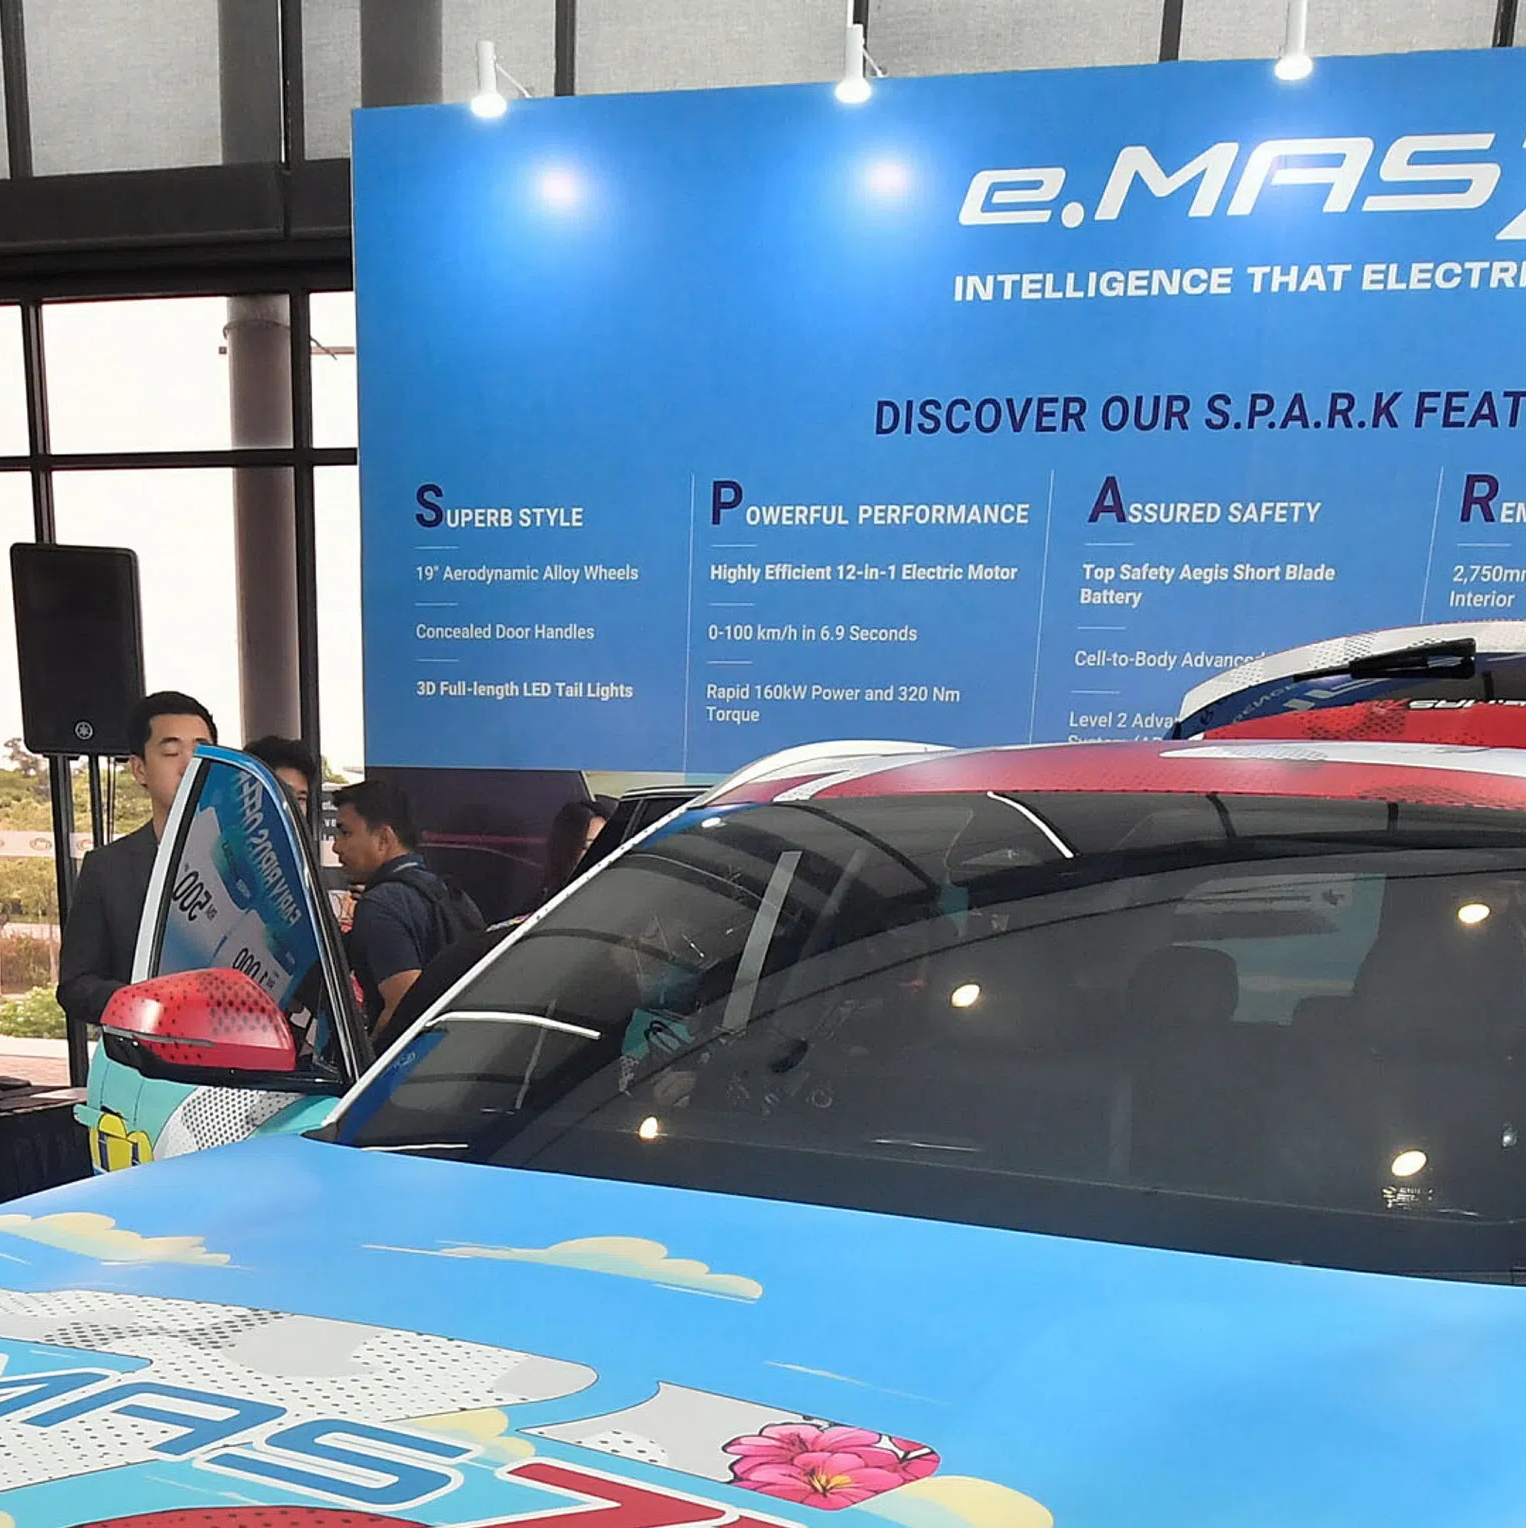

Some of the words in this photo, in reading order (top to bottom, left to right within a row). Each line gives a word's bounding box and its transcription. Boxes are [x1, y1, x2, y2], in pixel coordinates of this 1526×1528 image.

[953, 266, 1232, 303] INTELLIGENCE
[1247, 263, 1353, 293] THAT
[875, 397, 1088, 436] DISCOVER
[1102, 395, 1192, 432] OUR
[1206, 392, 1402, 431] S.P.A.R.K
[415, 483, 512, 528] SUPERB
[519, 508, 584, 527] STYLE
[711, 480, 849, 525] POWERFUL
[858, 504, 1030, 525] PERFORMANCE
[1088, 475, 1222, 523] ASSURED
[1228, 502, 1322, 523] SAFETY
[443, 565, 539, 584] Aerodynamic
[543, 565, 580, 584] Alloy
[584, 565, 639, 580] Wheels
[710, 564, 761, 583] Highly
[765, 563, 832, 580] Efficient
[836, 564, 897, 580] 12-in-1
[902, 563, 963, 580] Electric
[968, 564, 1018, 580] Motor
[1082, 563, 1115, 583] Top
[1119, 563, 1175, 584] Safety
[1179, 564, 1229, 585] Aegis
[1233, 564, 1281, 580] Short
[1285, 564, 1335, 581] Blade
[1079, 589, 1143, 608] Battery
[1449, 591, 1515, 607] Interior
[416, 623, 491, 639] Concealed
[495, 624, 530, 639] Door
[534, 624, 595, 639] Handles
[708, 625, 753, 640] 0-100
[757, 624, 797, 641] km/h
[802, 625, 816, 641] in
[820, 625, 845, 641] 6.9
[849, 625, 918, 641] Seconds
[1075, 650, 1177, 671] Cell-to-Body
[1180, 651, 1266, 668] Advanc
[416, 681, 436, 696] 3D
[439, 681, 519, 700] Full-length
[523, 682, 552, 697] LED
[555, 682, 583, 697] Tail
[587, 683, 634, 701] Lights
[706, 684, 750, 703] Rapid
[755, 684, 807, 700] 160kW
[811, 686, 861, 701] Power
[864, 686, 894, 701] and
[898, 686, 928, 702] 320
[933, 687, 961, 702] Nm
[706, 707, 760, 724] Torque
[1069, 711, 1113, 728] Level
[1116, 713, 1127, 728] 2
